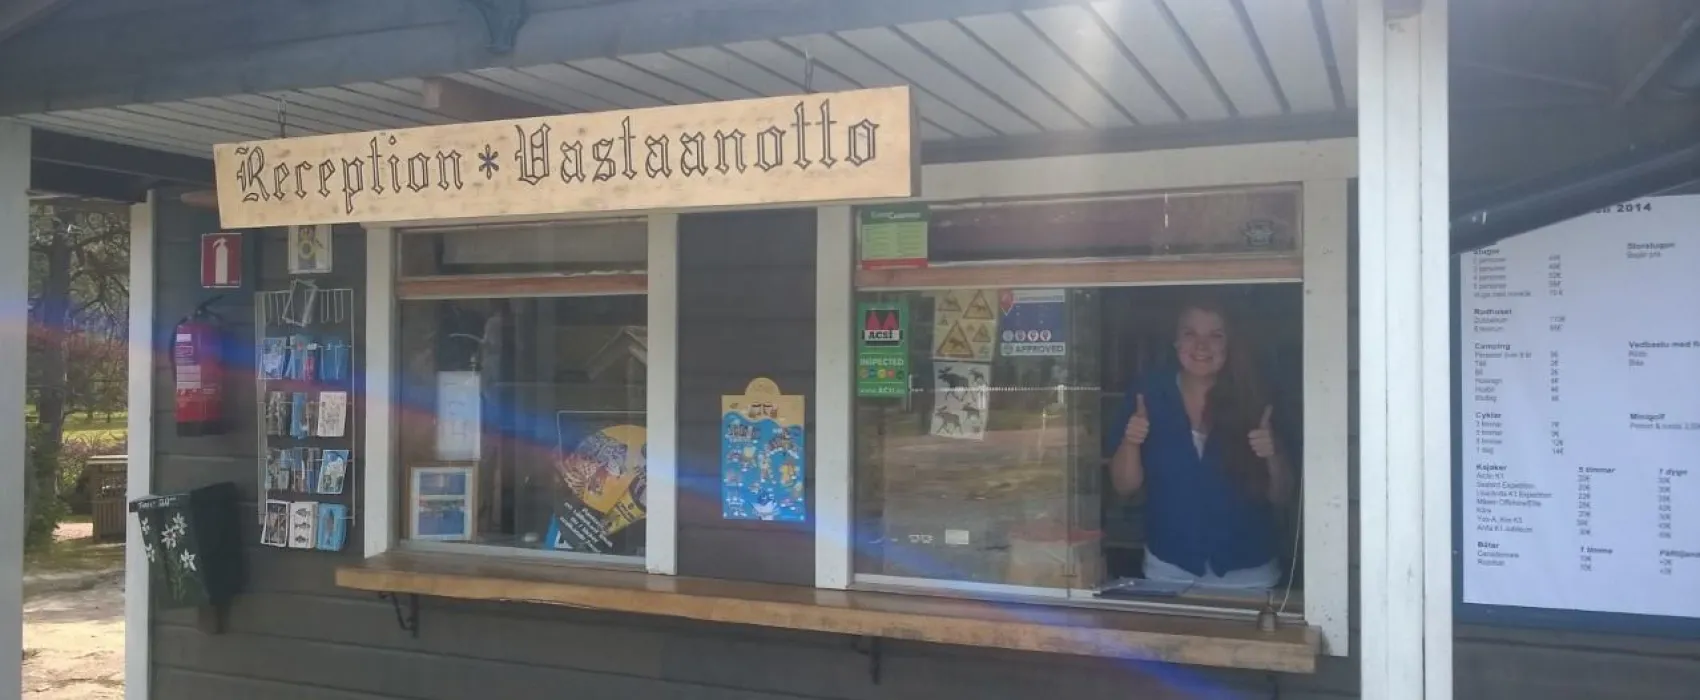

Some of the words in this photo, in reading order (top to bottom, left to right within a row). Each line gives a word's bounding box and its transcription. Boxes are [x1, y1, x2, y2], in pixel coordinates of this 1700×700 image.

[237, 135, 464, 215] Reception
[515, 98, 880, 187] Vastaanotto
[1617, 202, 1652, 213] 2014
[1016, 345, 1063, 354] APPROVED
[1474, 342, 1511, 351] Camping
[860, 357, 904, 366] INSPECTED
[1476, 411, 1502, 421] Cyklar
[1476, 463, 1508, 472] Kajaker
